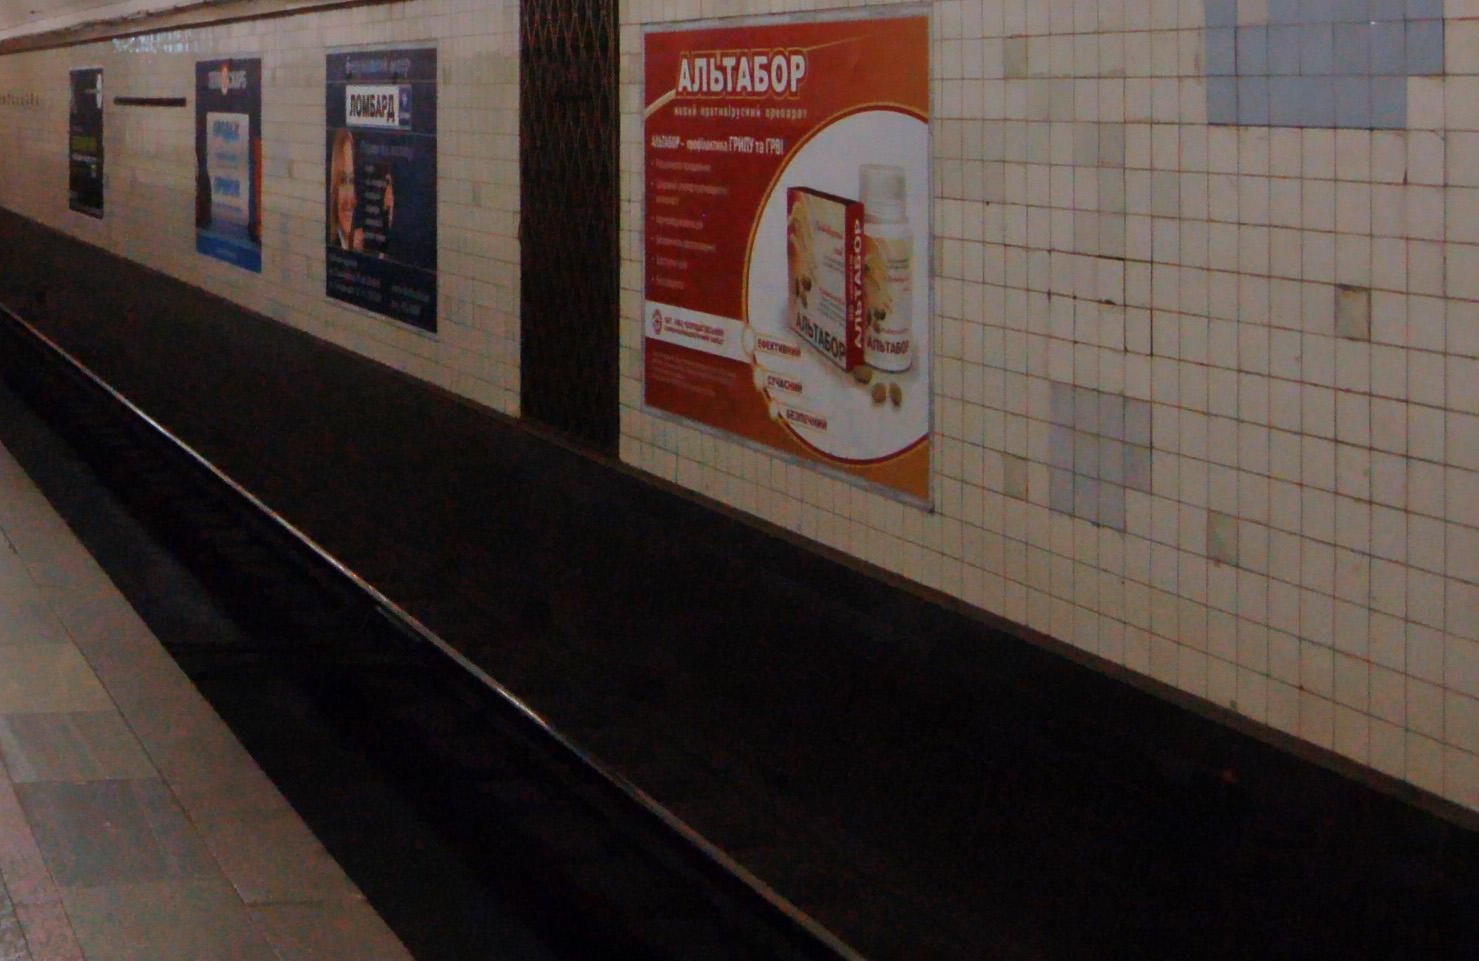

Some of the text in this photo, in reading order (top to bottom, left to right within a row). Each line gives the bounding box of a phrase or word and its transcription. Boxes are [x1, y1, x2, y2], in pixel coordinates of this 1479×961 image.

[677, 55, 806, 93] АЛЬТАБОР
[349, 94, 395, 123] ЛОМБАРД
[795, 311, 846, 361] АЛЬТАБОР
